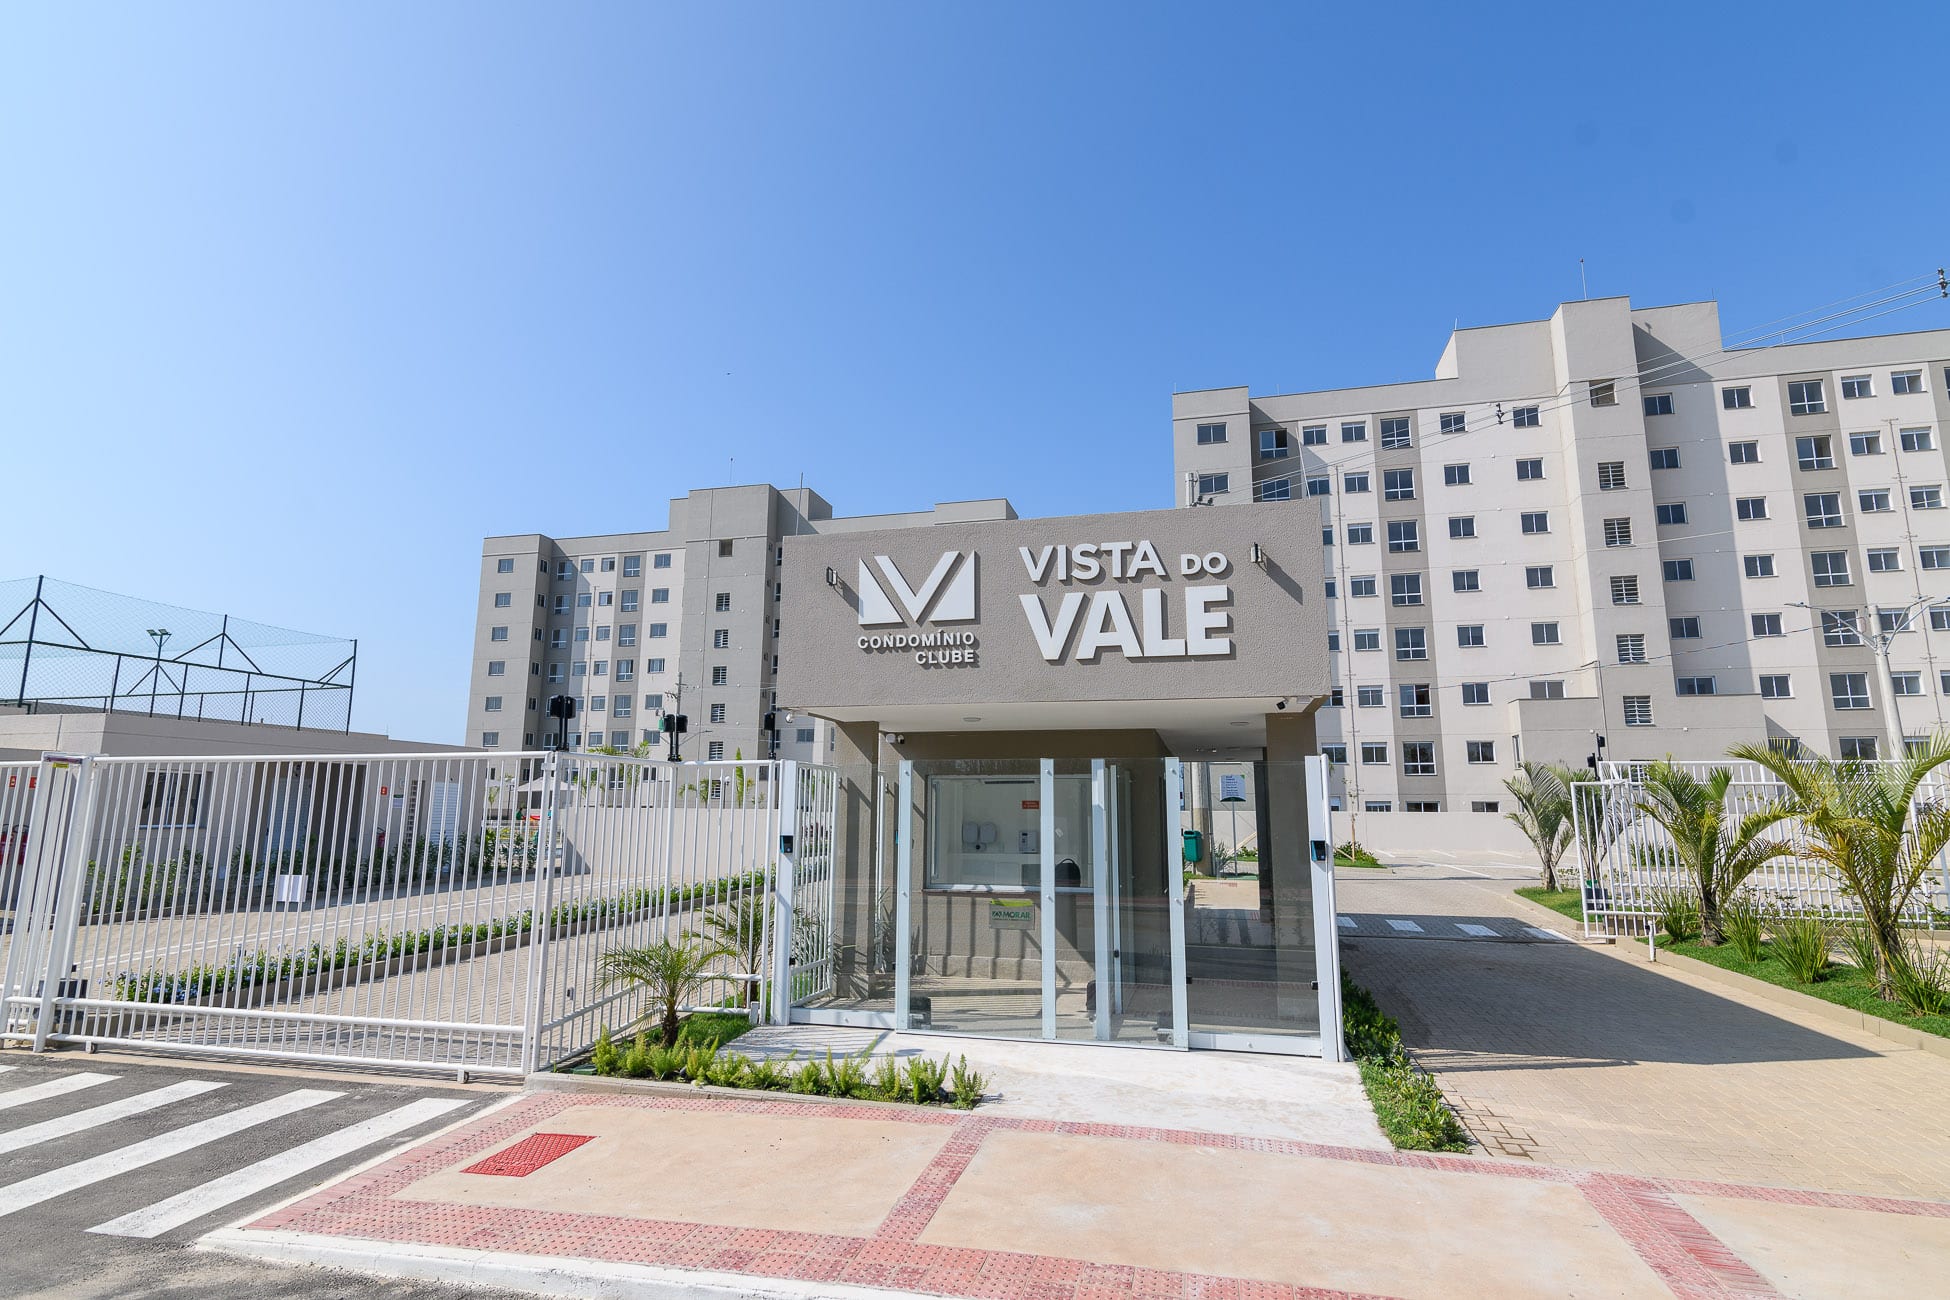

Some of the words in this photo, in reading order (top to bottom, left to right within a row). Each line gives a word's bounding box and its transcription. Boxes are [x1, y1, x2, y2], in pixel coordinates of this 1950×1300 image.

[1018, 540, 1167, 582] VISTA
[1180, 551, 1228, 575] DO
[1018, 584, 1231, 660] VALE
[857, 628, 975, 649] CONDOMÍNIO
[915, 649, 975, 664] CLUBE
